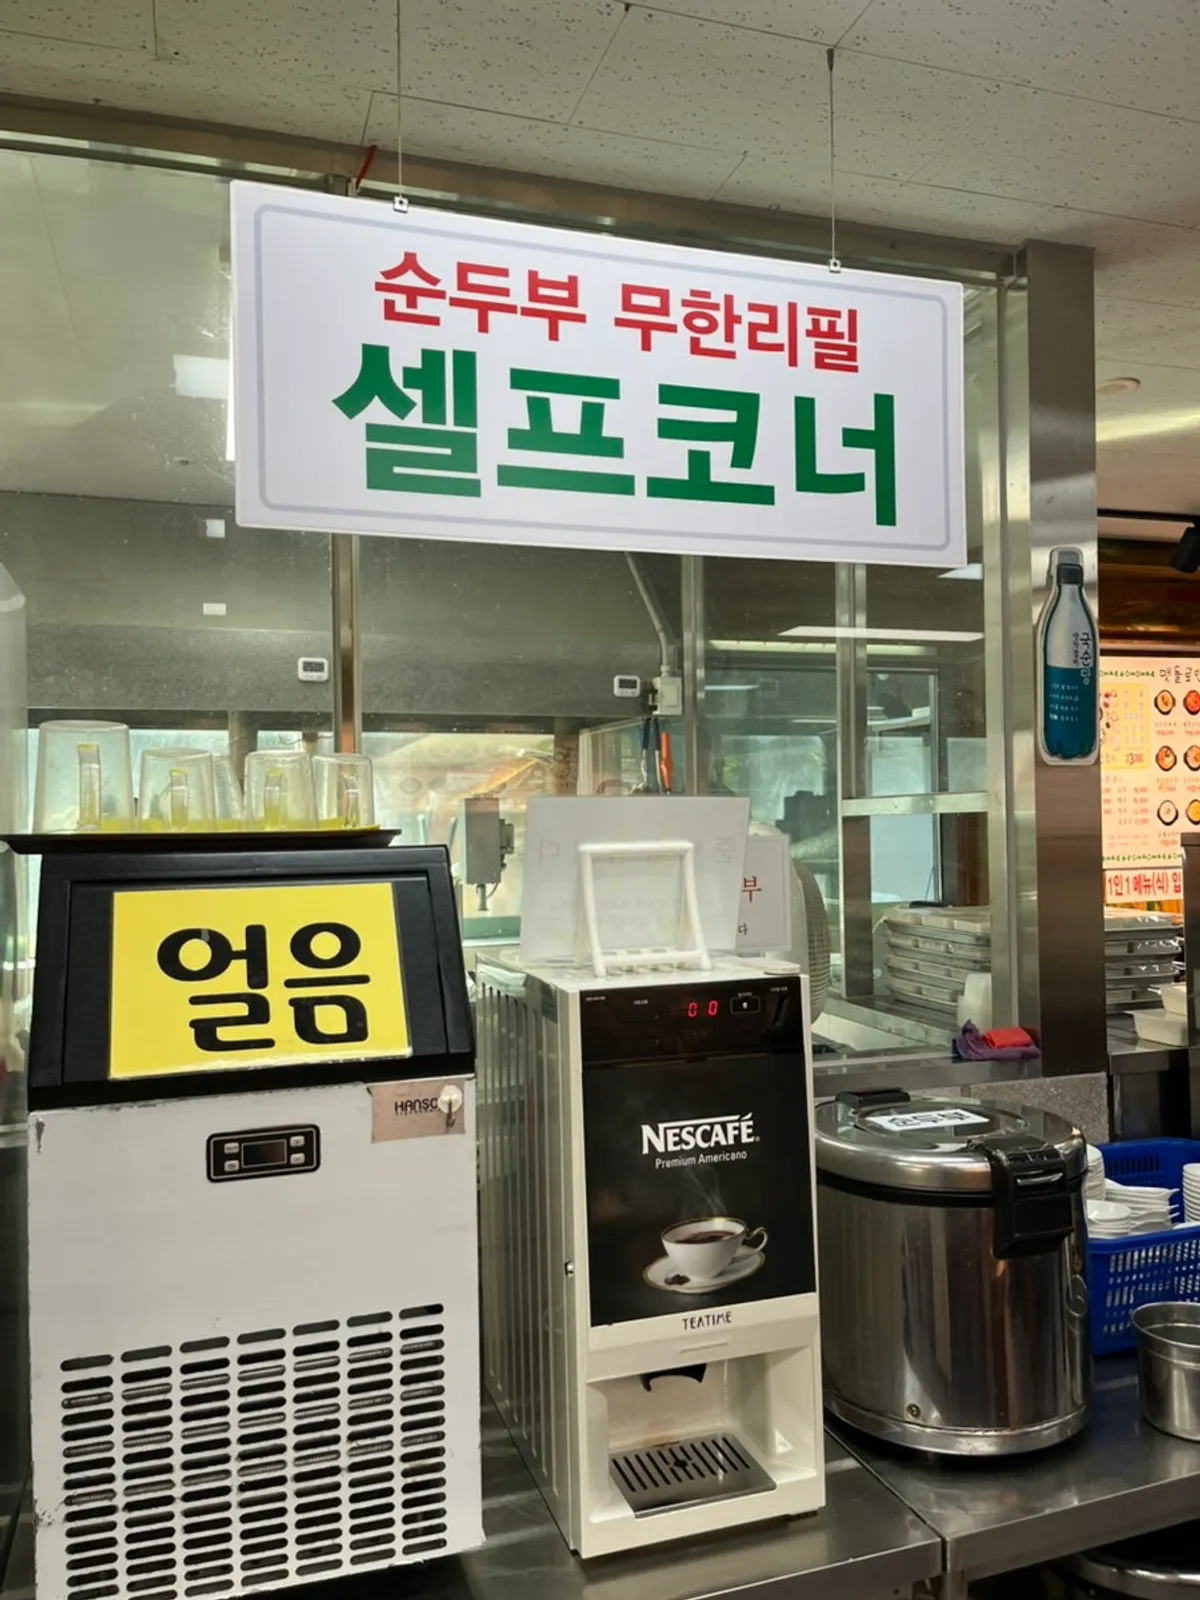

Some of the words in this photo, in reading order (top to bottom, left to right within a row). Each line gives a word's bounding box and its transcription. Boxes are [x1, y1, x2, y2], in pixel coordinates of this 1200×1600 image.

[375, 251, 587, 342] 순두부
[614, 283, 860, 373] 무한리필
[332, 343, 897, 527] 셀프코너
[157, 921, 371, 1052] 얼음
[655, 1156, 697, 1169] Premium
[698, 1150, 748, 1165] Americano
[681, 1310, 732, 1330] TEATIME
